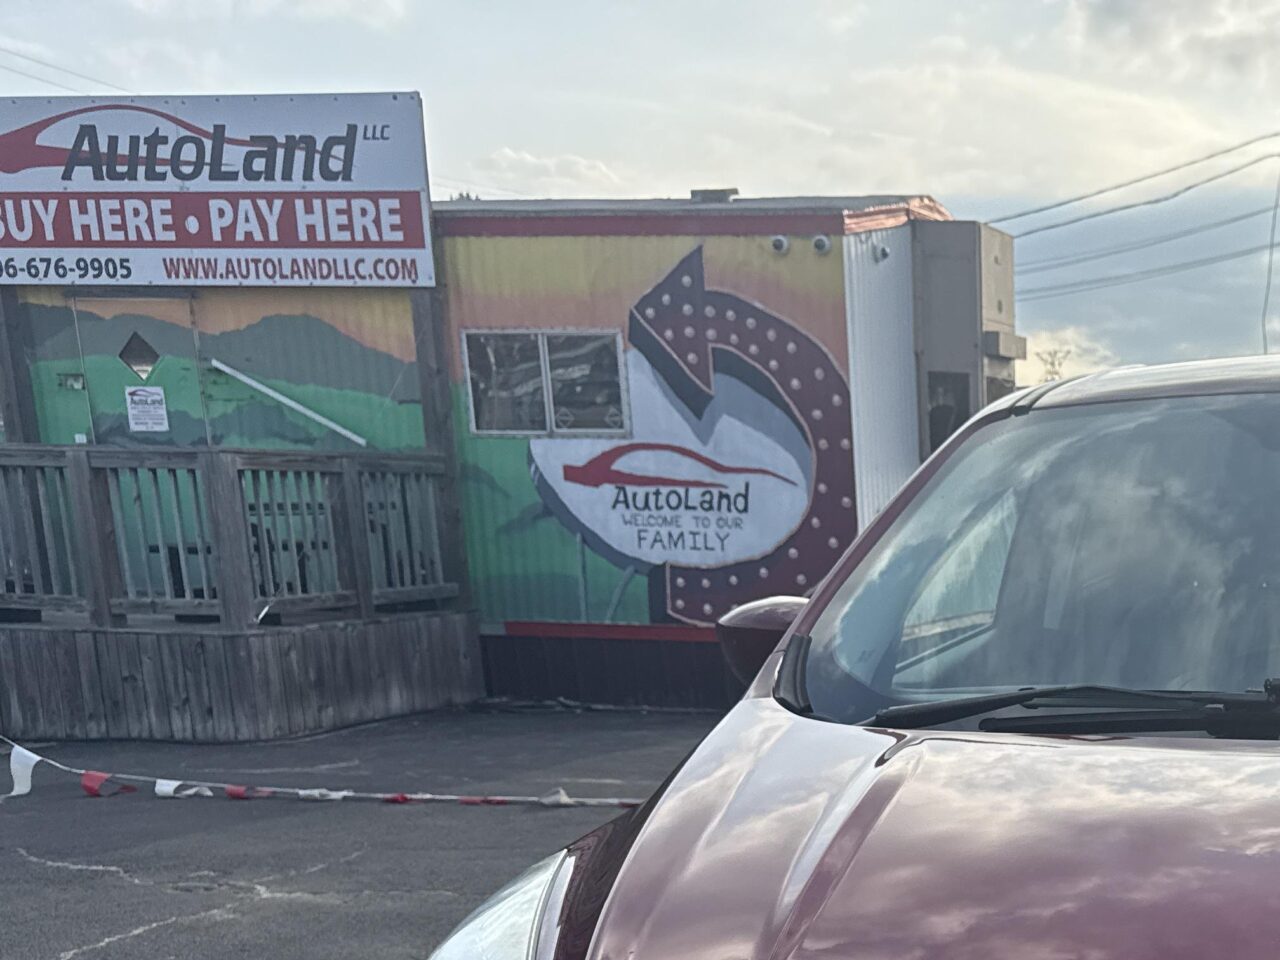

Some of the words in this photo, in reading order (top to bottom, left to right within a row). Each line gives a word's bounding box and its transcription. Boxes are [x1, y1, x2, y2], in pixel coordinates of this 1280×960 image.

[61, 123, 358, 182] AutoLand
[363, 124, 390, 141] LLC
[0, 198, 59, 242] UY
[69, 198, 176, 242] HERE
[209, 198, 284, 242] PAY
[294, 198, 405, 242] HERE
[0, 257, 132, 279] 6-676-9905
[163, 257, 419, 281] WWW.AUTOLANDLLC.COM
[611, 481, 750, 514] AutoLand
[621, 514, 683, 529] WELCOME
[692, 515, 711, 529] TO
[715, 515, 743, 530] OUR
[637, 529, 730, 552] FAMILY
